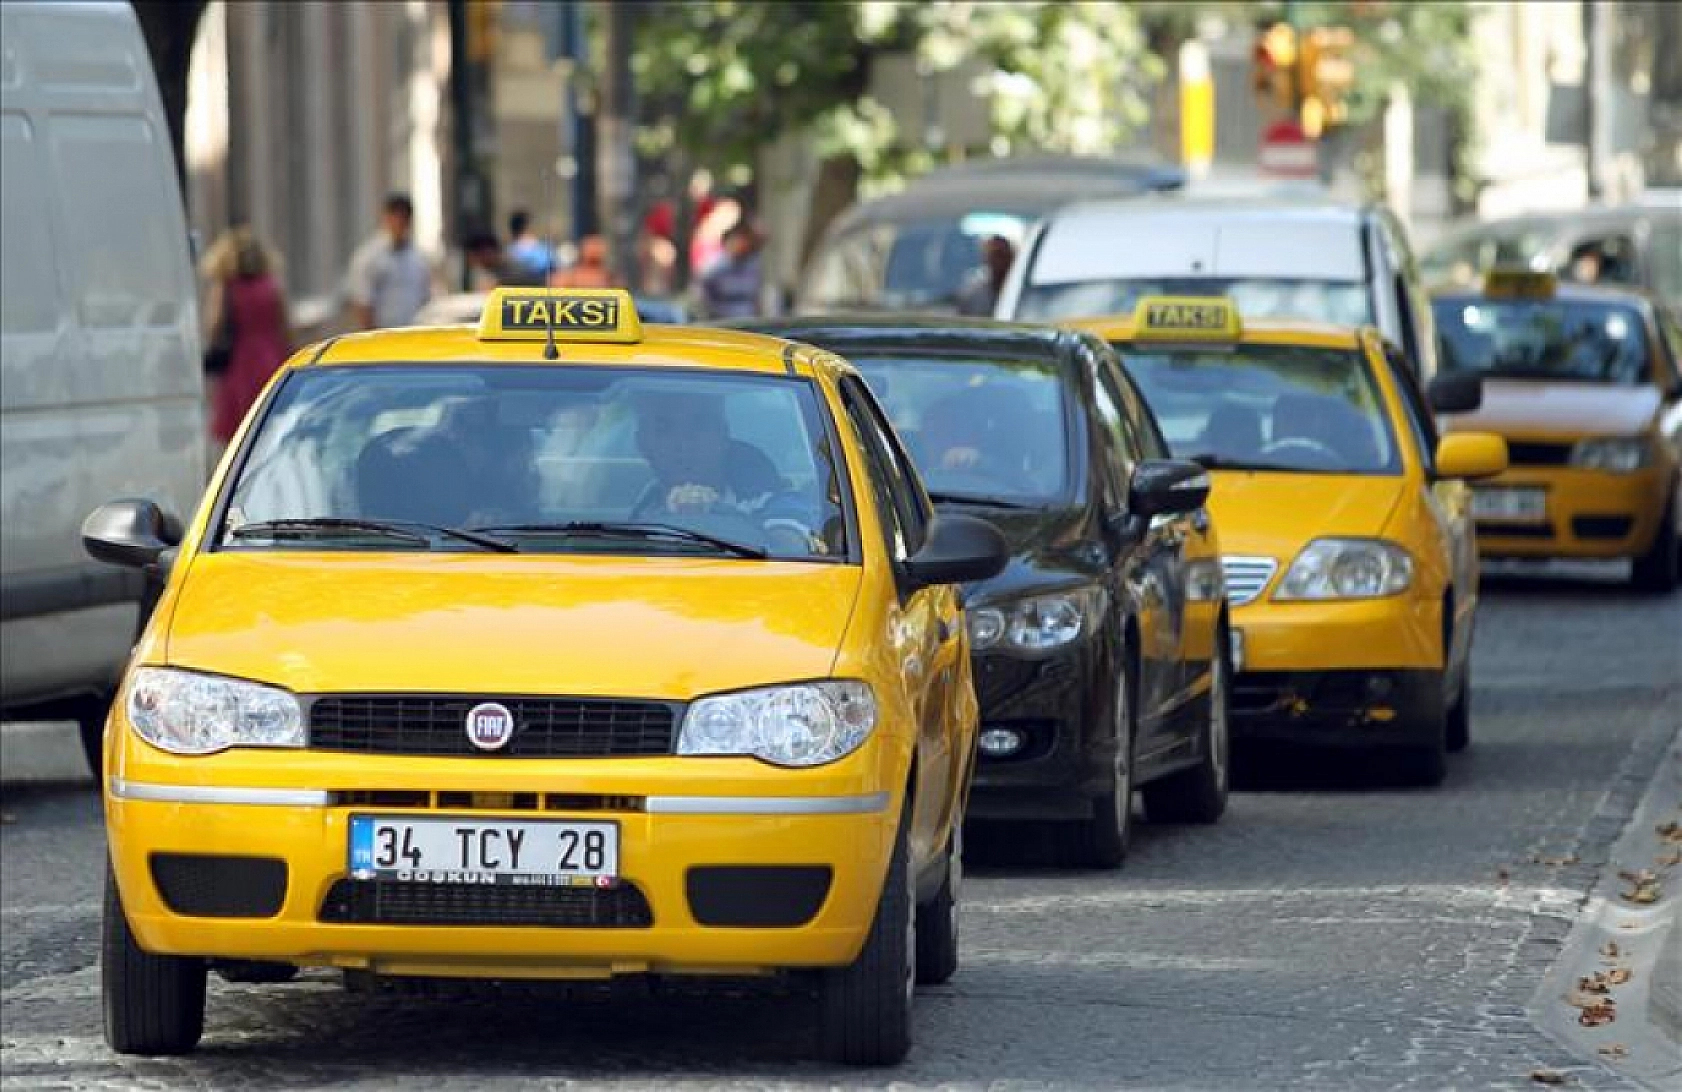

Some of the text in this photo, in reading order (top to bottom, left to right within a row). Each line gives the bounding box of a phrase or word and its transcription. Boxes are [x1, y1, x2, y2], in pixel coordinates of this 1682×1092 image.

[376, 826, 605, 870] 34 TCY 28
